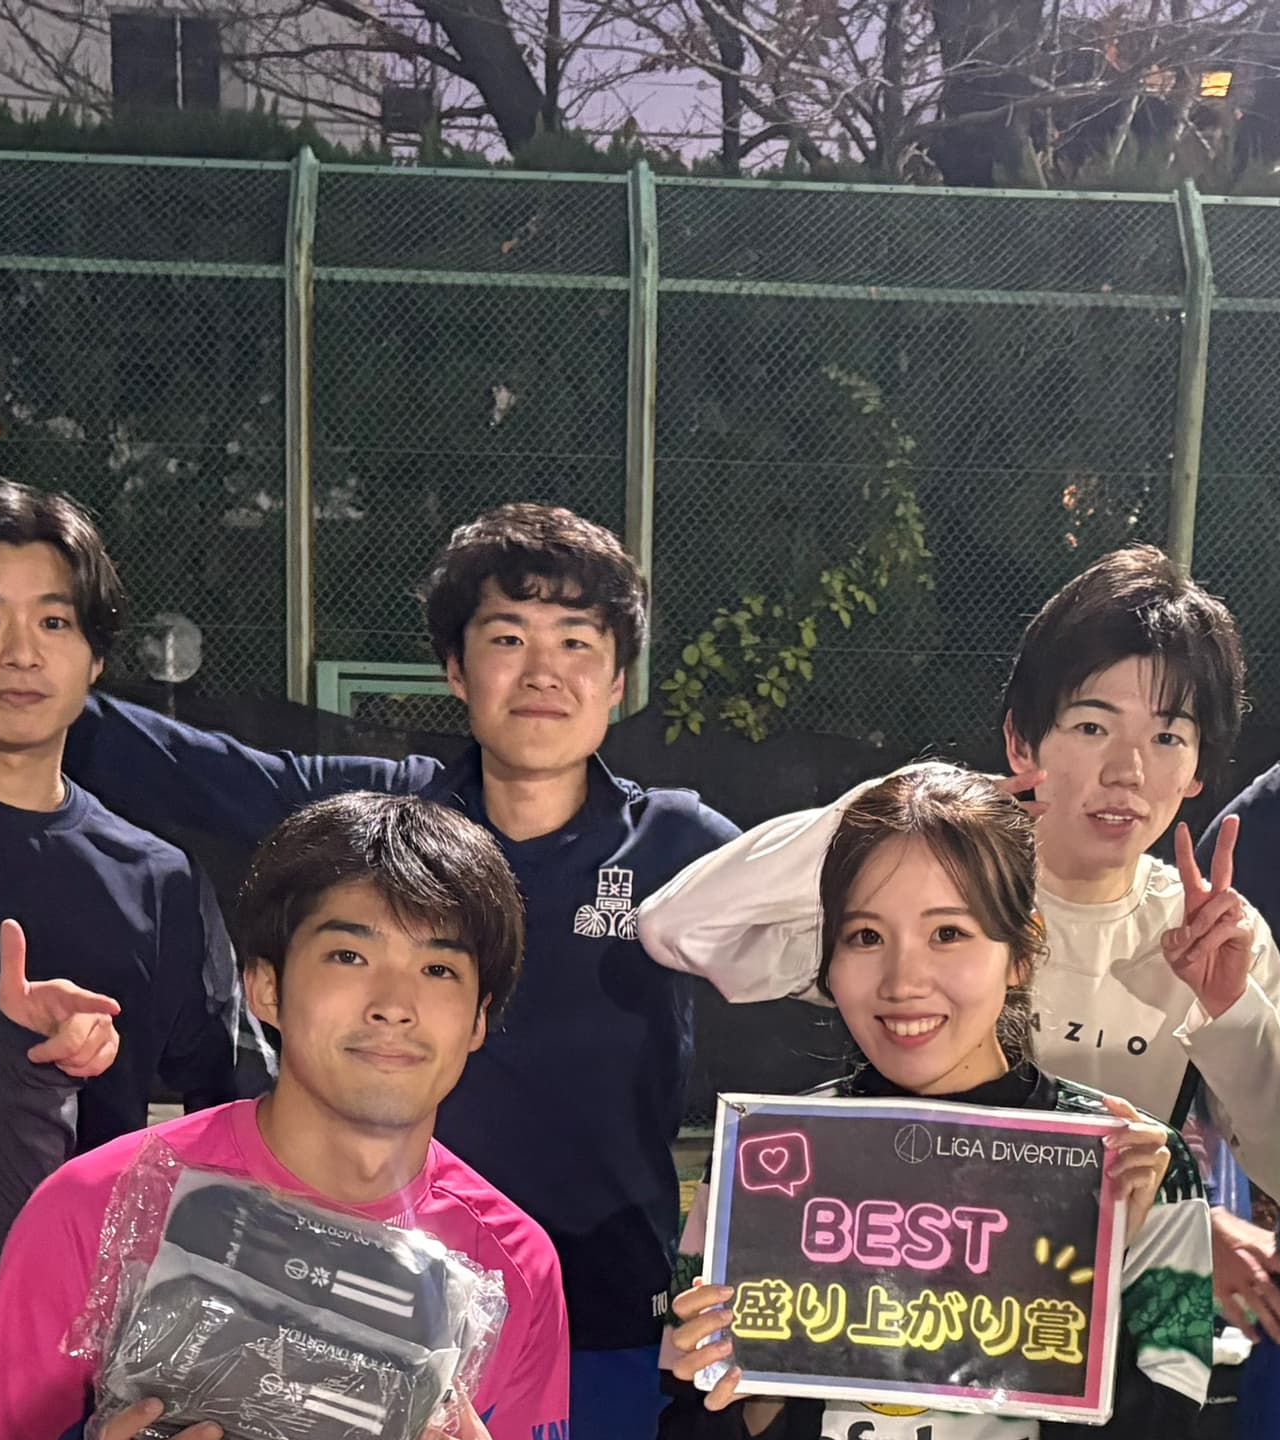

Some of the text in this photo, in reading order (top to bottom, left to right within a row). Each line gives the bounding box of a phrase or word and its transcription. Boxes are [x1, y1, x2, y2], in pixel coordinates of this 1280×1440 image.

[801, 1197, 1008, 1274] BEST
[732, 1278, 1086, 1363] 盛り上がり賞
